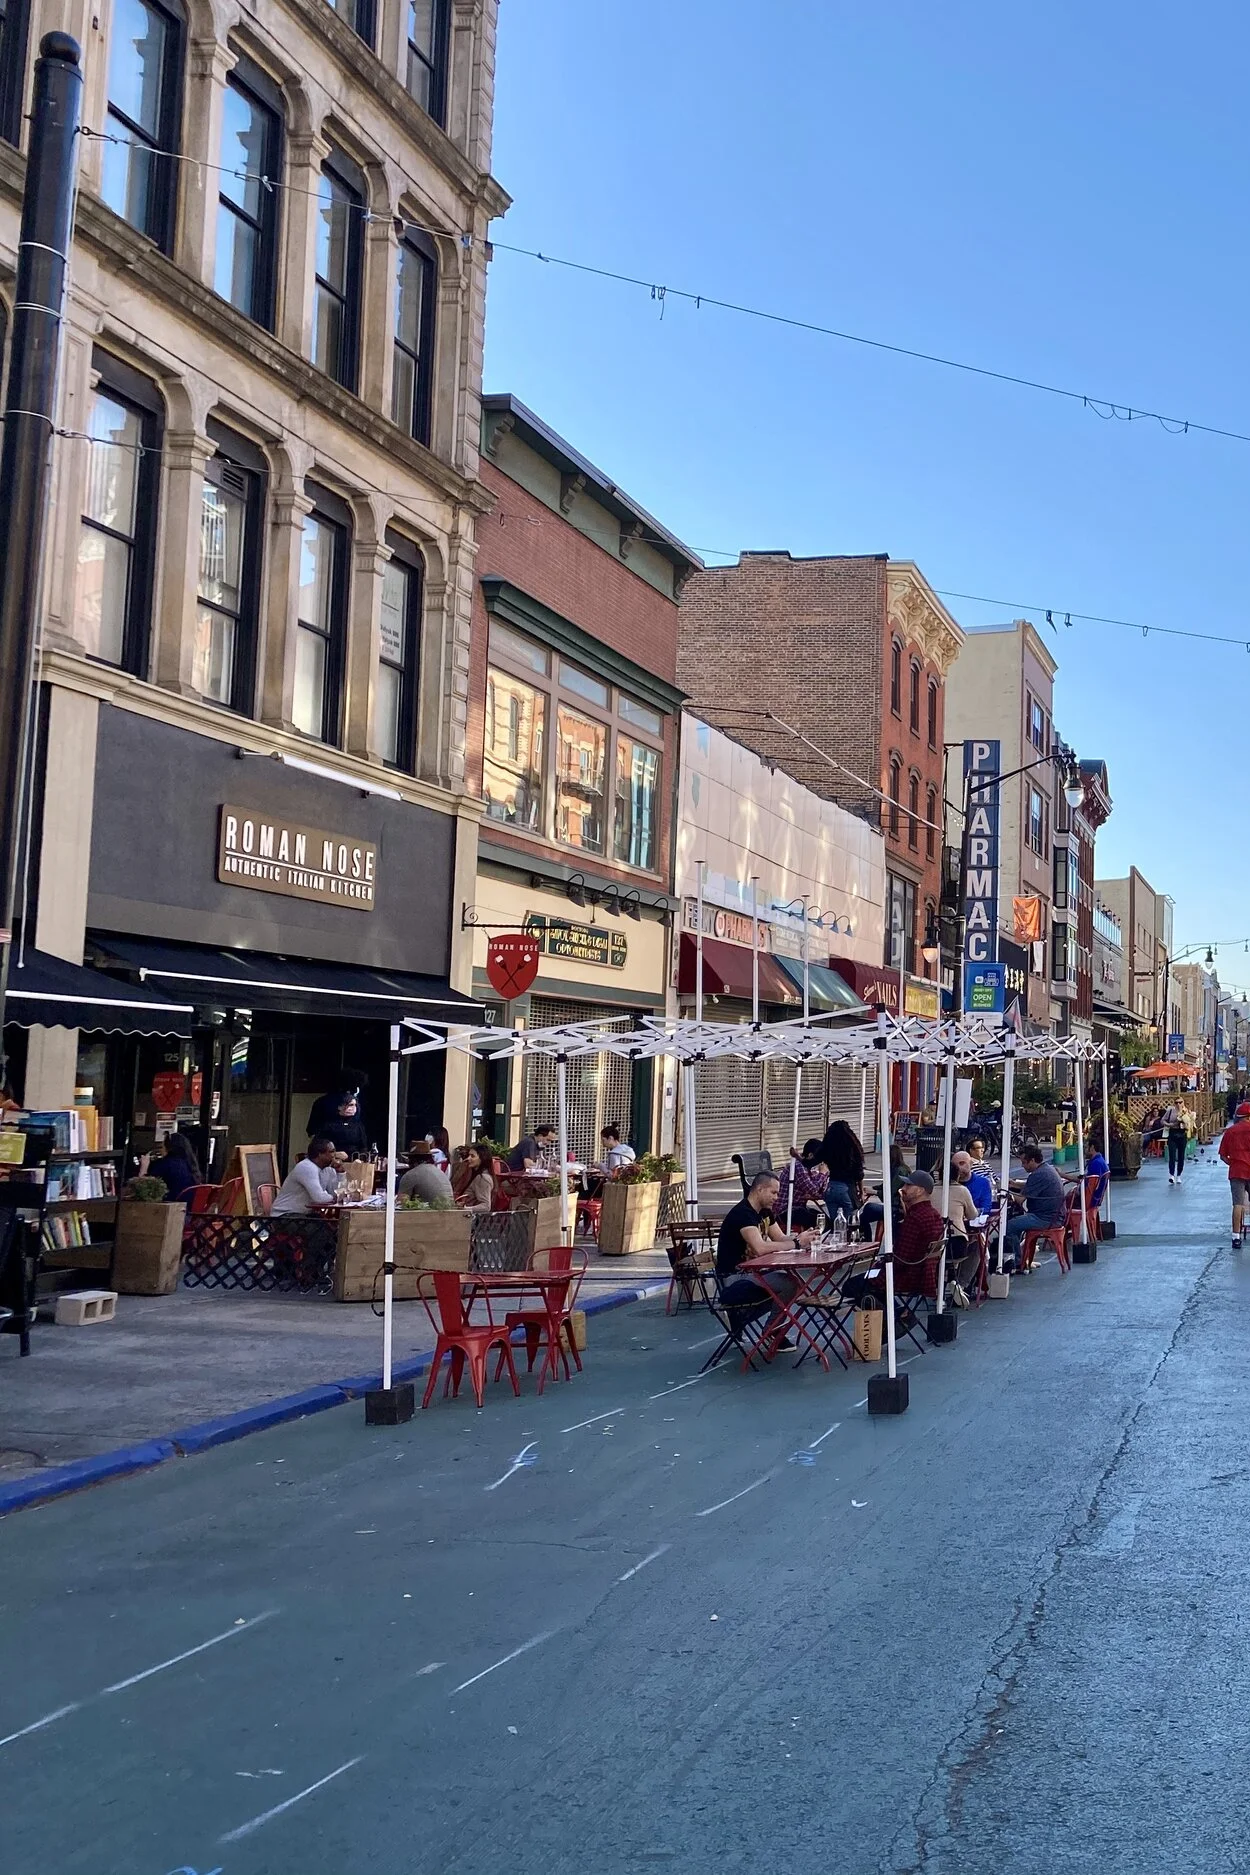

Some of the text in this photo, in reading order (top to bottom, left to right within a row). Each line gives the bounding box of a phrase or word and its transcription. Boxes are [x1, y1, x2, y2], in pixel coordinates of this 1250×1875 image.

[225, 815, 375, 881] ROMAN NOSE
[966, 742, 993, 962] PHARMAC
[224, 856, 373, 901] AUTHENTIC ITALIAN KITCHEN
[876, 981, 897, 1007] NAILS
[484, 1009, 497, 1024] 127
[164, 1053, 179, 1062] 125
